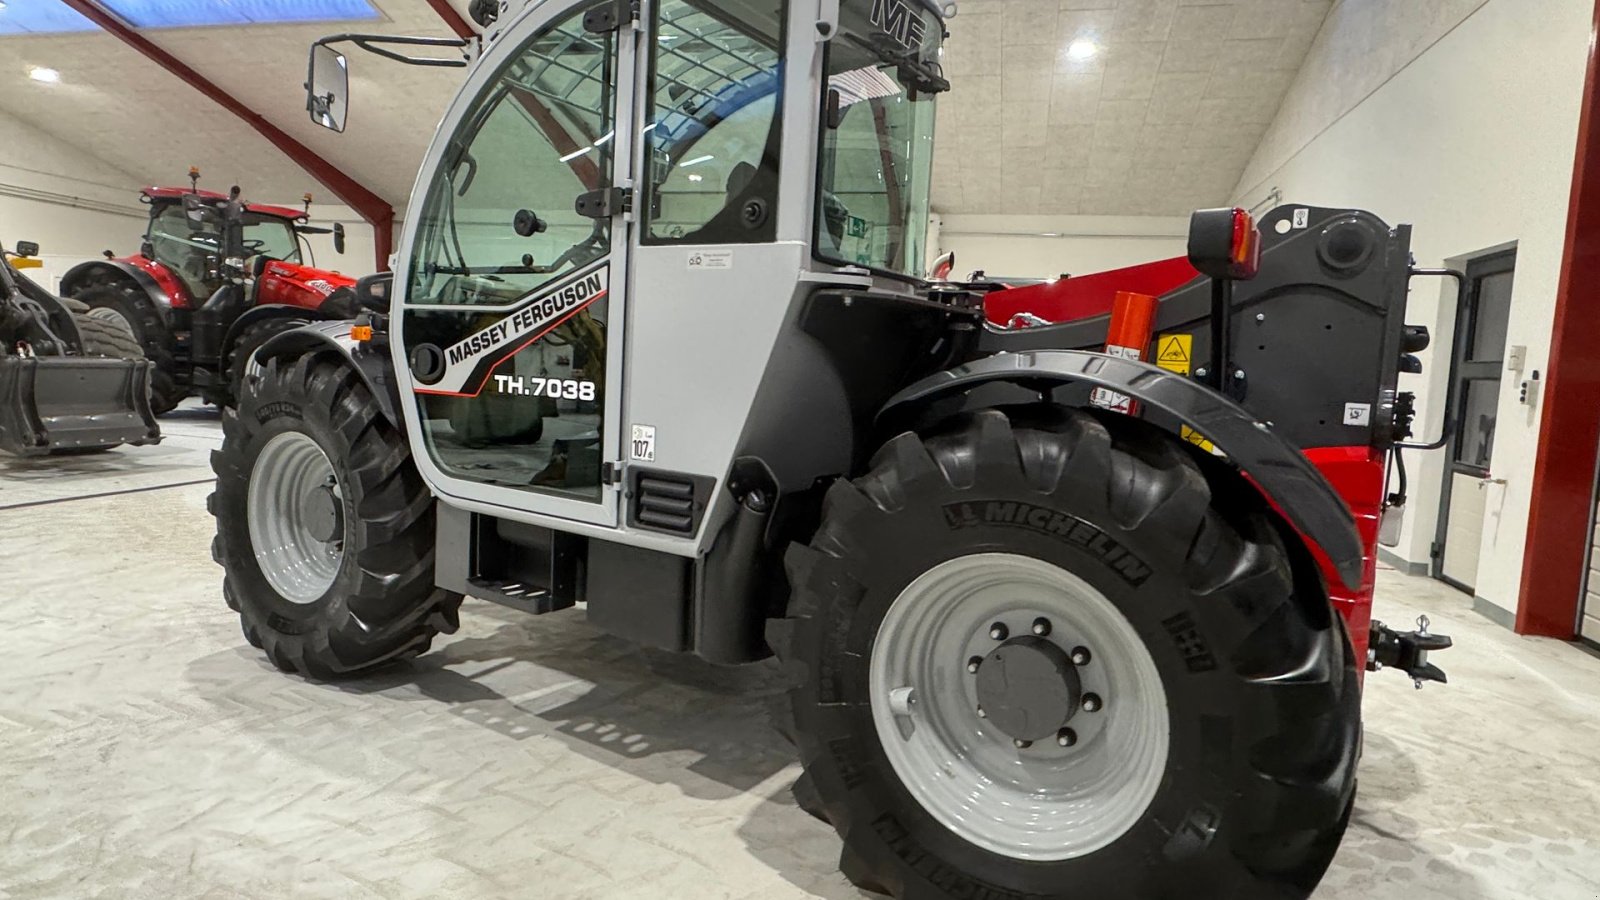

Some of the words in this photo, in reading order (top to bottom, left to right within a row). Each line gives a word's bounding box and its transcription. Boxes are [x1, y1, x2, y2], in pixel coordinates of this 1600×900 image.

[871, 0, 927, 48] MF
[449, 321, 508, 365] MASSEY
[514, 274, 601, 333] FERGUSON
[494, 375, 595, 400] TH.7038
[633, 440, 649, 457] 107
[984, 501, 1148, 582] MICHELIN
